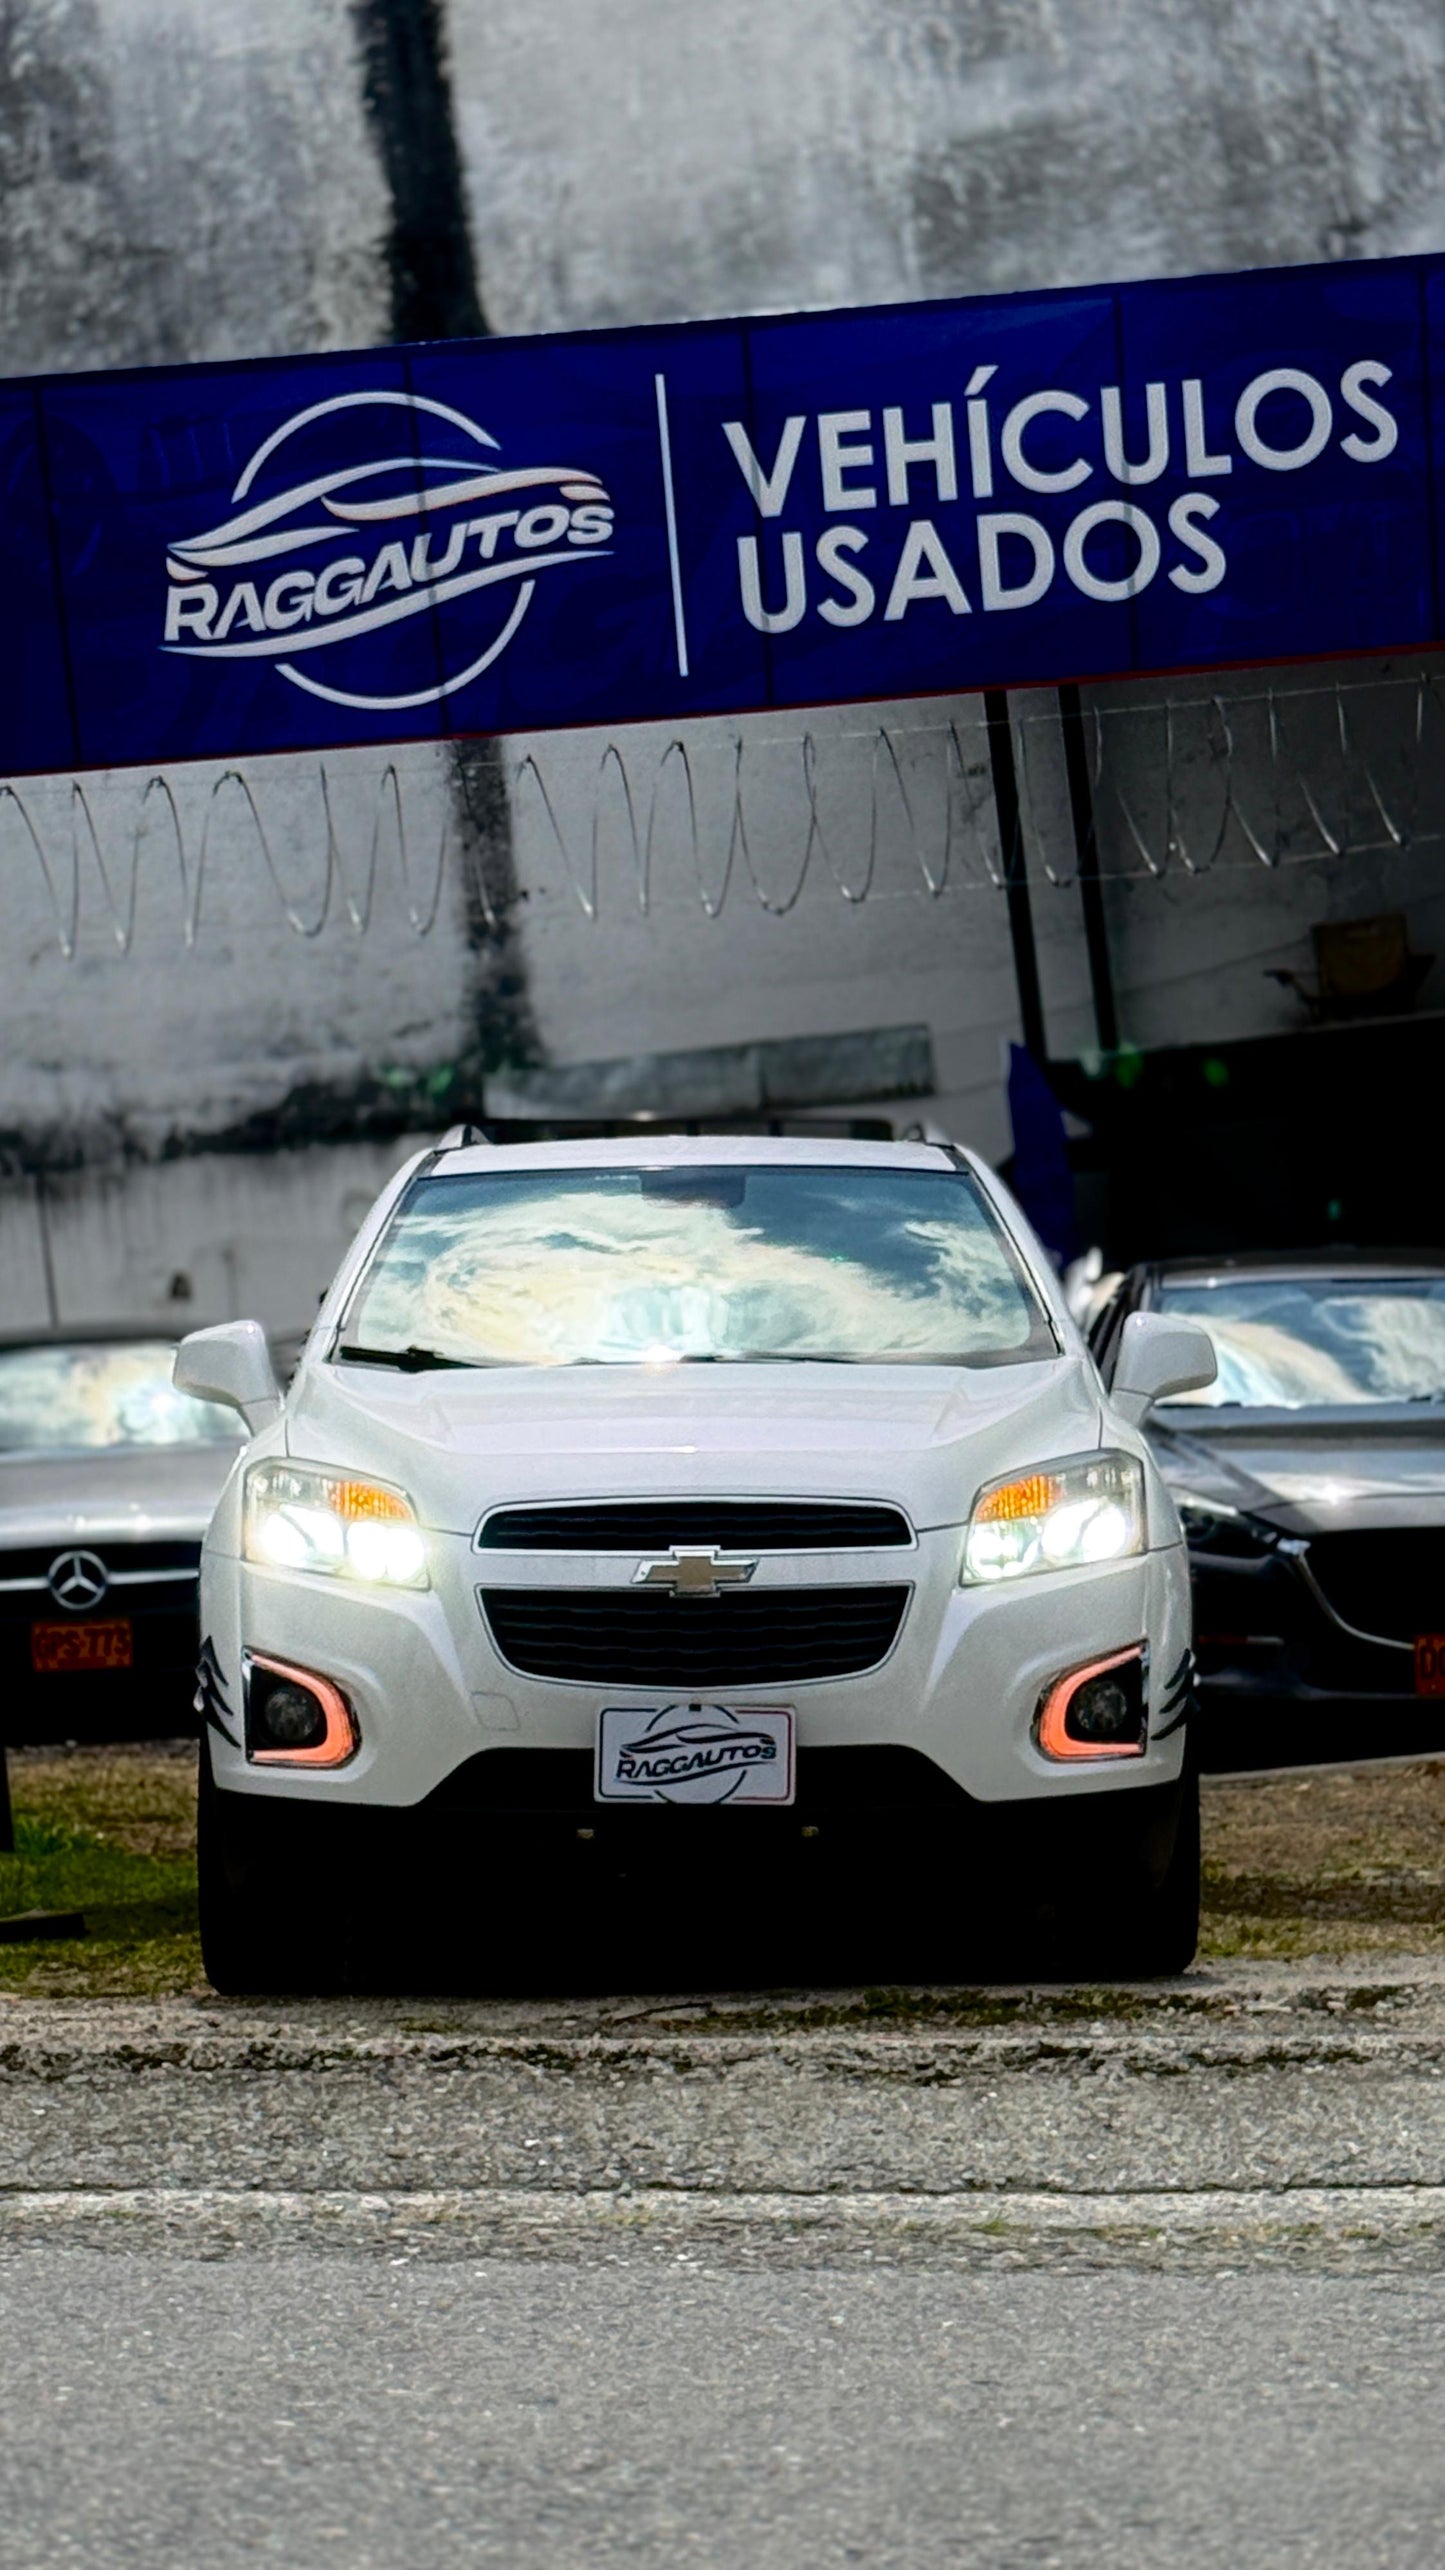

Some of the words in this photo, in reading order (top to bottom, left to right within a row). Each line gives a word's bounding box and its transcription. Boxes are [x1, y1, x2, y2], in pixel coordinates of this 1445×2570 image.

[721, 360, 1399, 519] VEHÍCULOS
[164, 504, 616, 642] RAGGAUTOS
[736, 492, 1227, 634] USADOS
[616, 1745, 777, 1779] RAGGAUTOS
